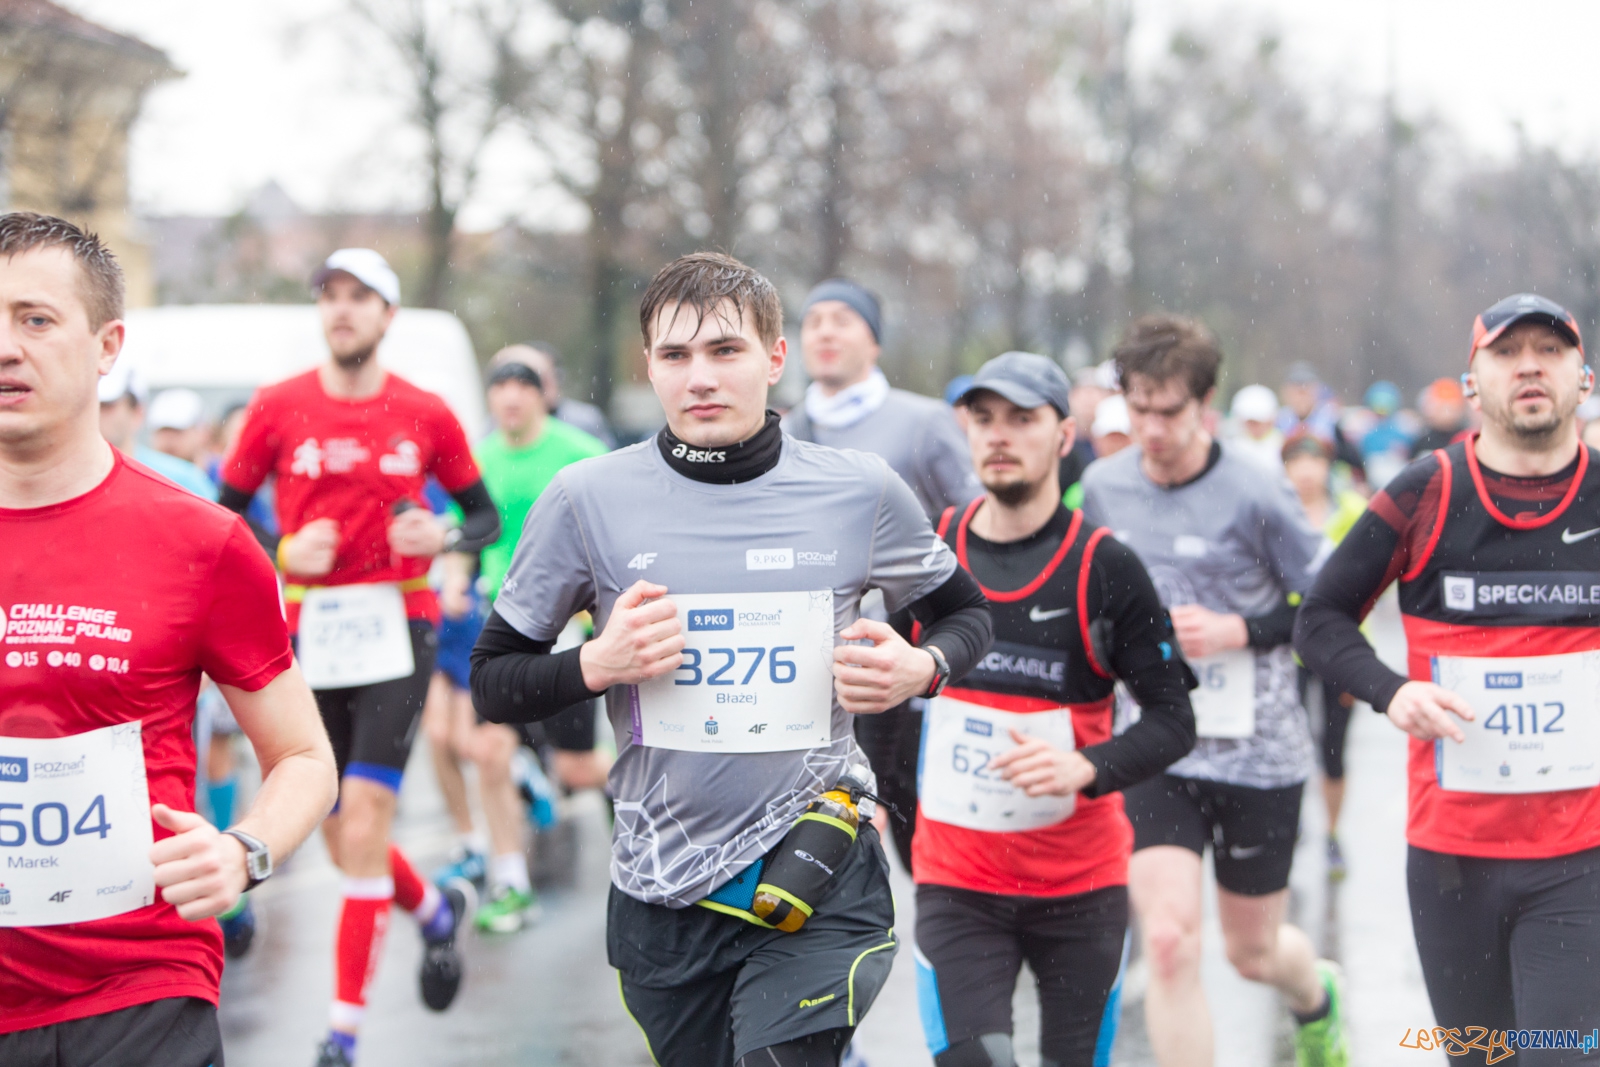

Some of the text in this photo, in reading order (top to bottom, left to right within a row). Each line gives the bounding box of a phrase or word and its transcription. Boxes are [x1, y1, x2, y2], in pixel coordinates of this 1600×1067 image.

[686, 449, 727, 463] asics
[627, 552, 657, 570] 4F
[1478, 584, 1600, 605] SPECKABLE
[9, 603, 117, 625] CHALLENGE
[6, 618, 66, 634] POZNAŃ
[75, 622, 132, 642] POLAND
[23, 651, 39, 667] 1,5
[63, 652, 82, 667] 40
[106, 656, 130, 674] 10,4
[674, 646, 797, 685] 3276
[976, 651, 1065, 682] CKABLE
[716, 693, 757, 705] Błażej
[1483, 702, 1565, 735] 4112
[748, 723, 768, 735] 4F
[7, 856, 60, 869] Marek
[48, 890, 73, 903] 4F
